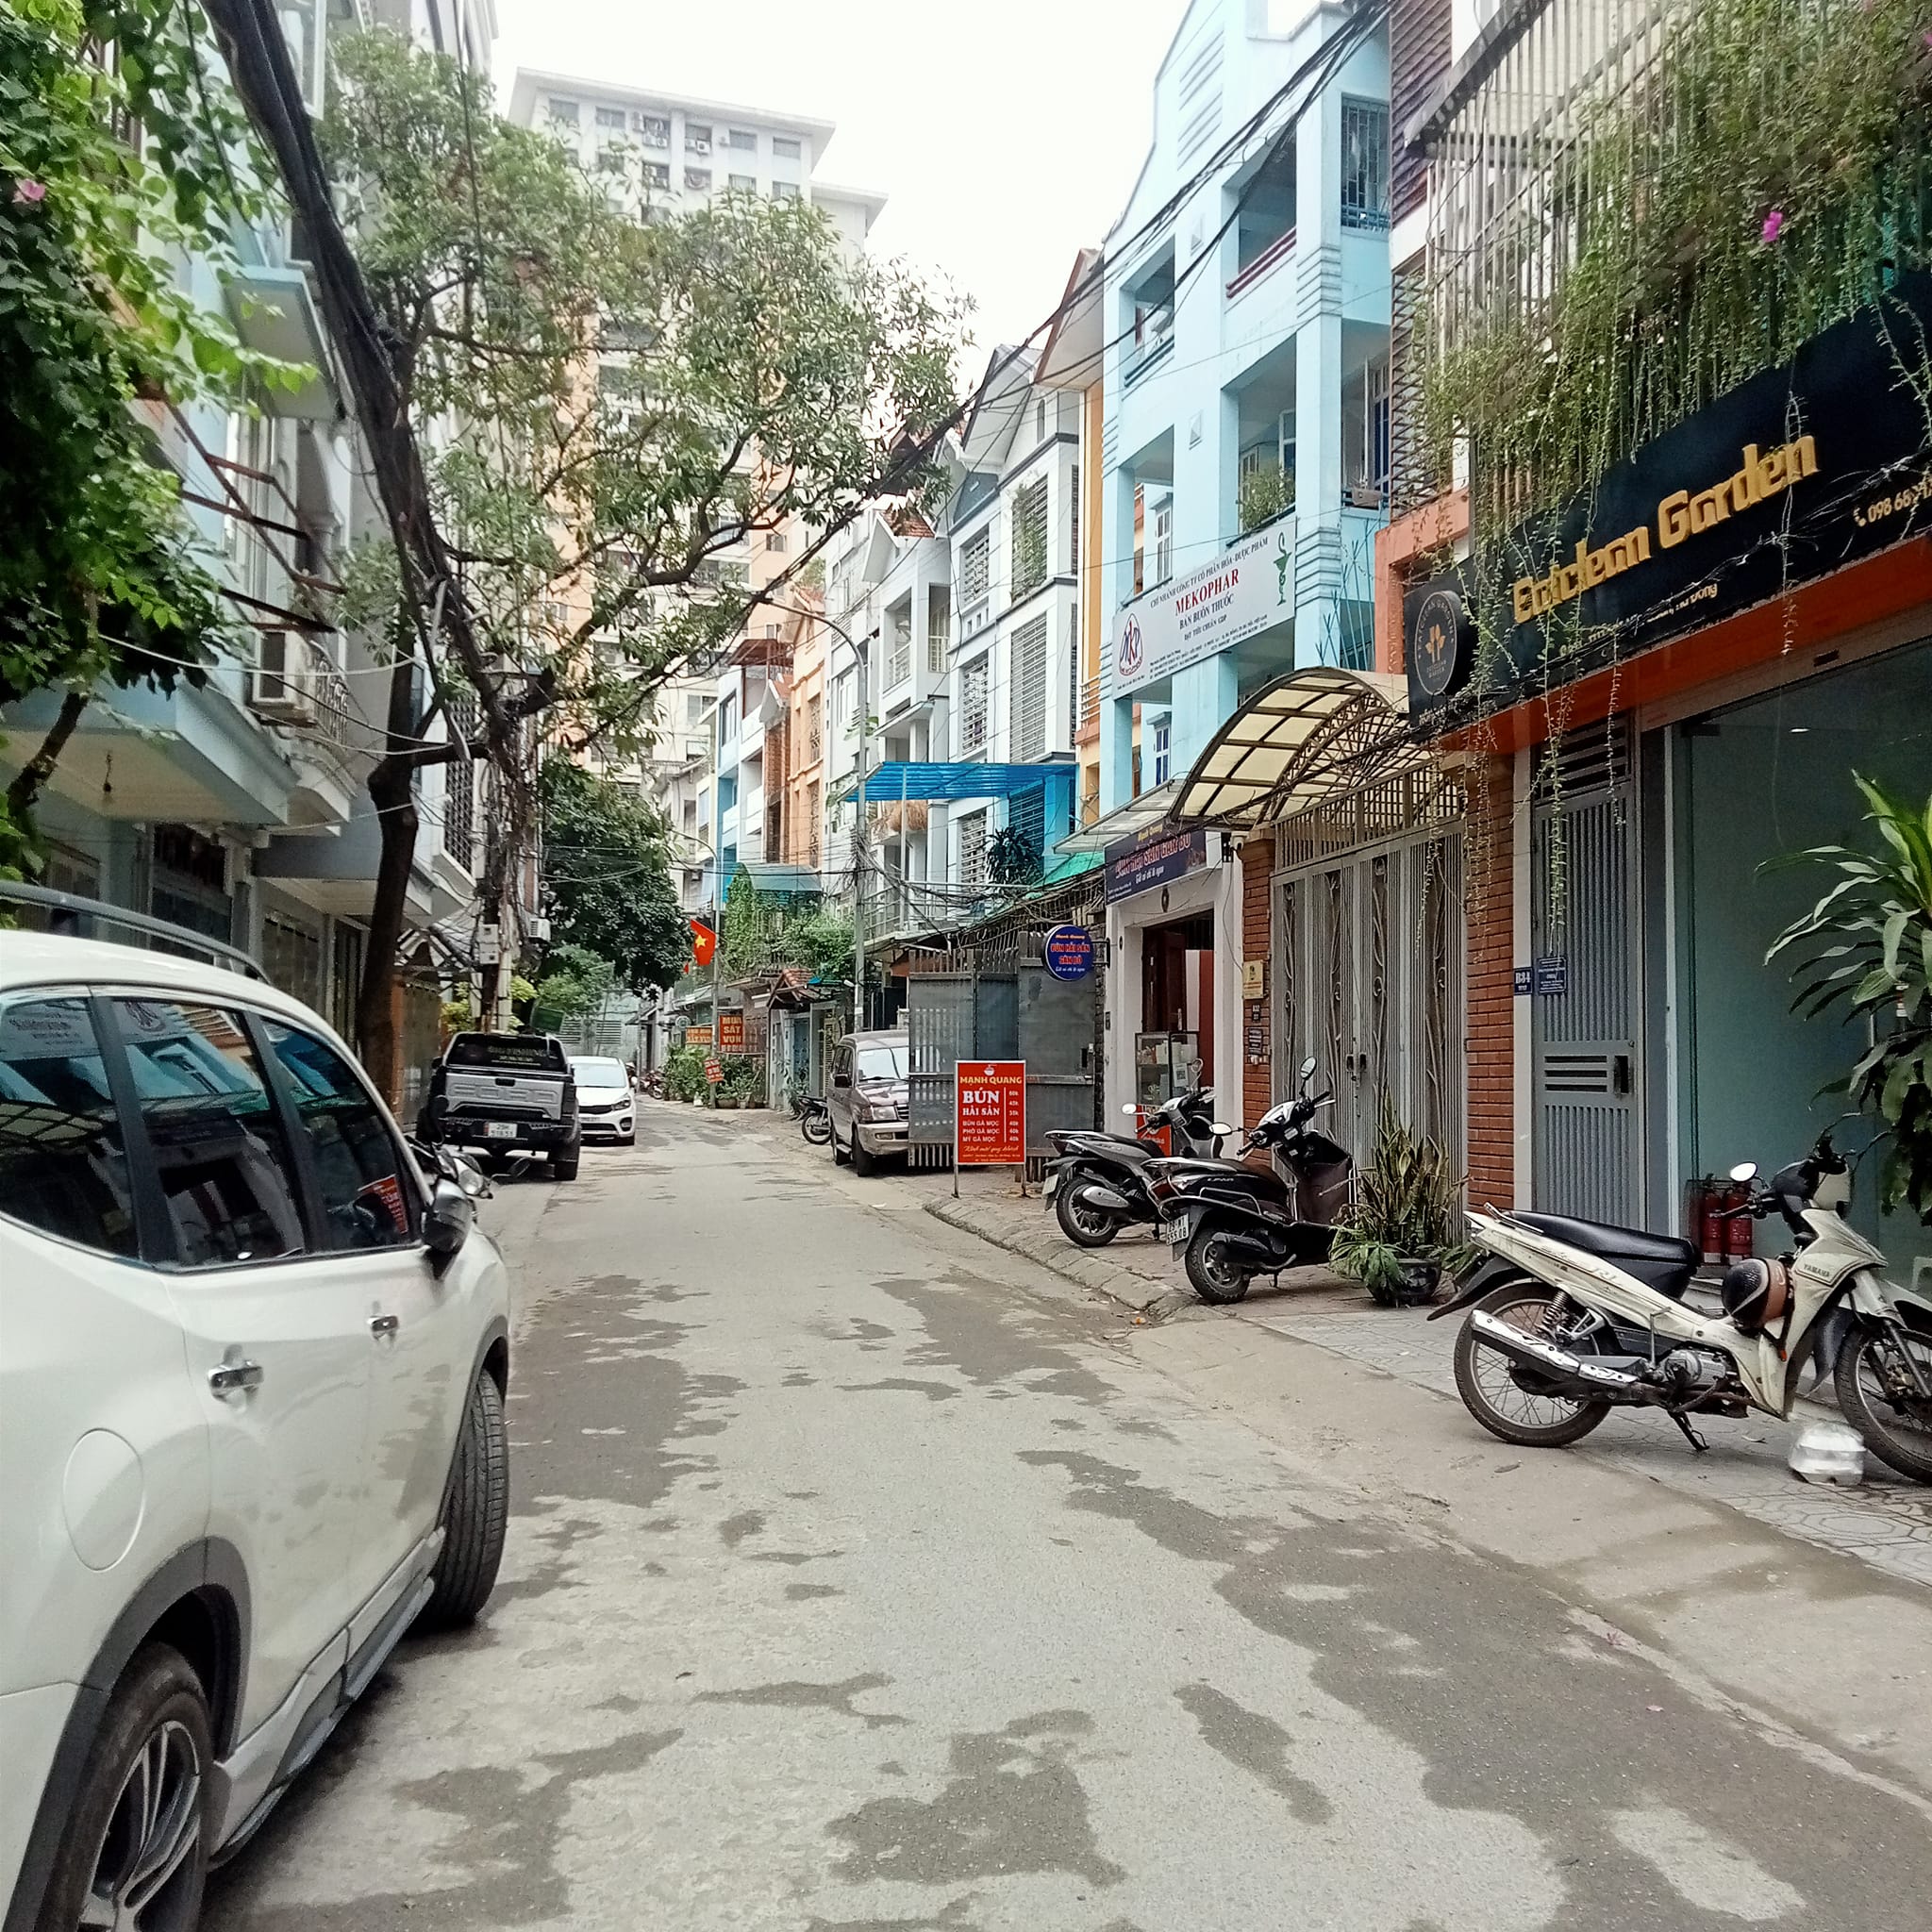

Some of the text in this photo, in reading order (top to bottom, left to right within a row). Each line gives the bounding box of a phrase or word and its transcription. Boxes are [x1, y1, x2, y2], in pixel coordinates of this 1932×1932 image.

[1657, 435, 1820, 549] Garden
[1868, 497, 1892, 523] 098
[1175, 568, 1240, 616] MEKOPHAR
[1211, 591, 1234, 615] THUỐC
[960, 1076, 1022, 1086] MẠNH QUANG
[962, 1087, 999, 1104] BÚN
[962, 1105, 1000, 1116] HẢI SẢN
[1803, 1264, 1830, 1277] YAMAHA
